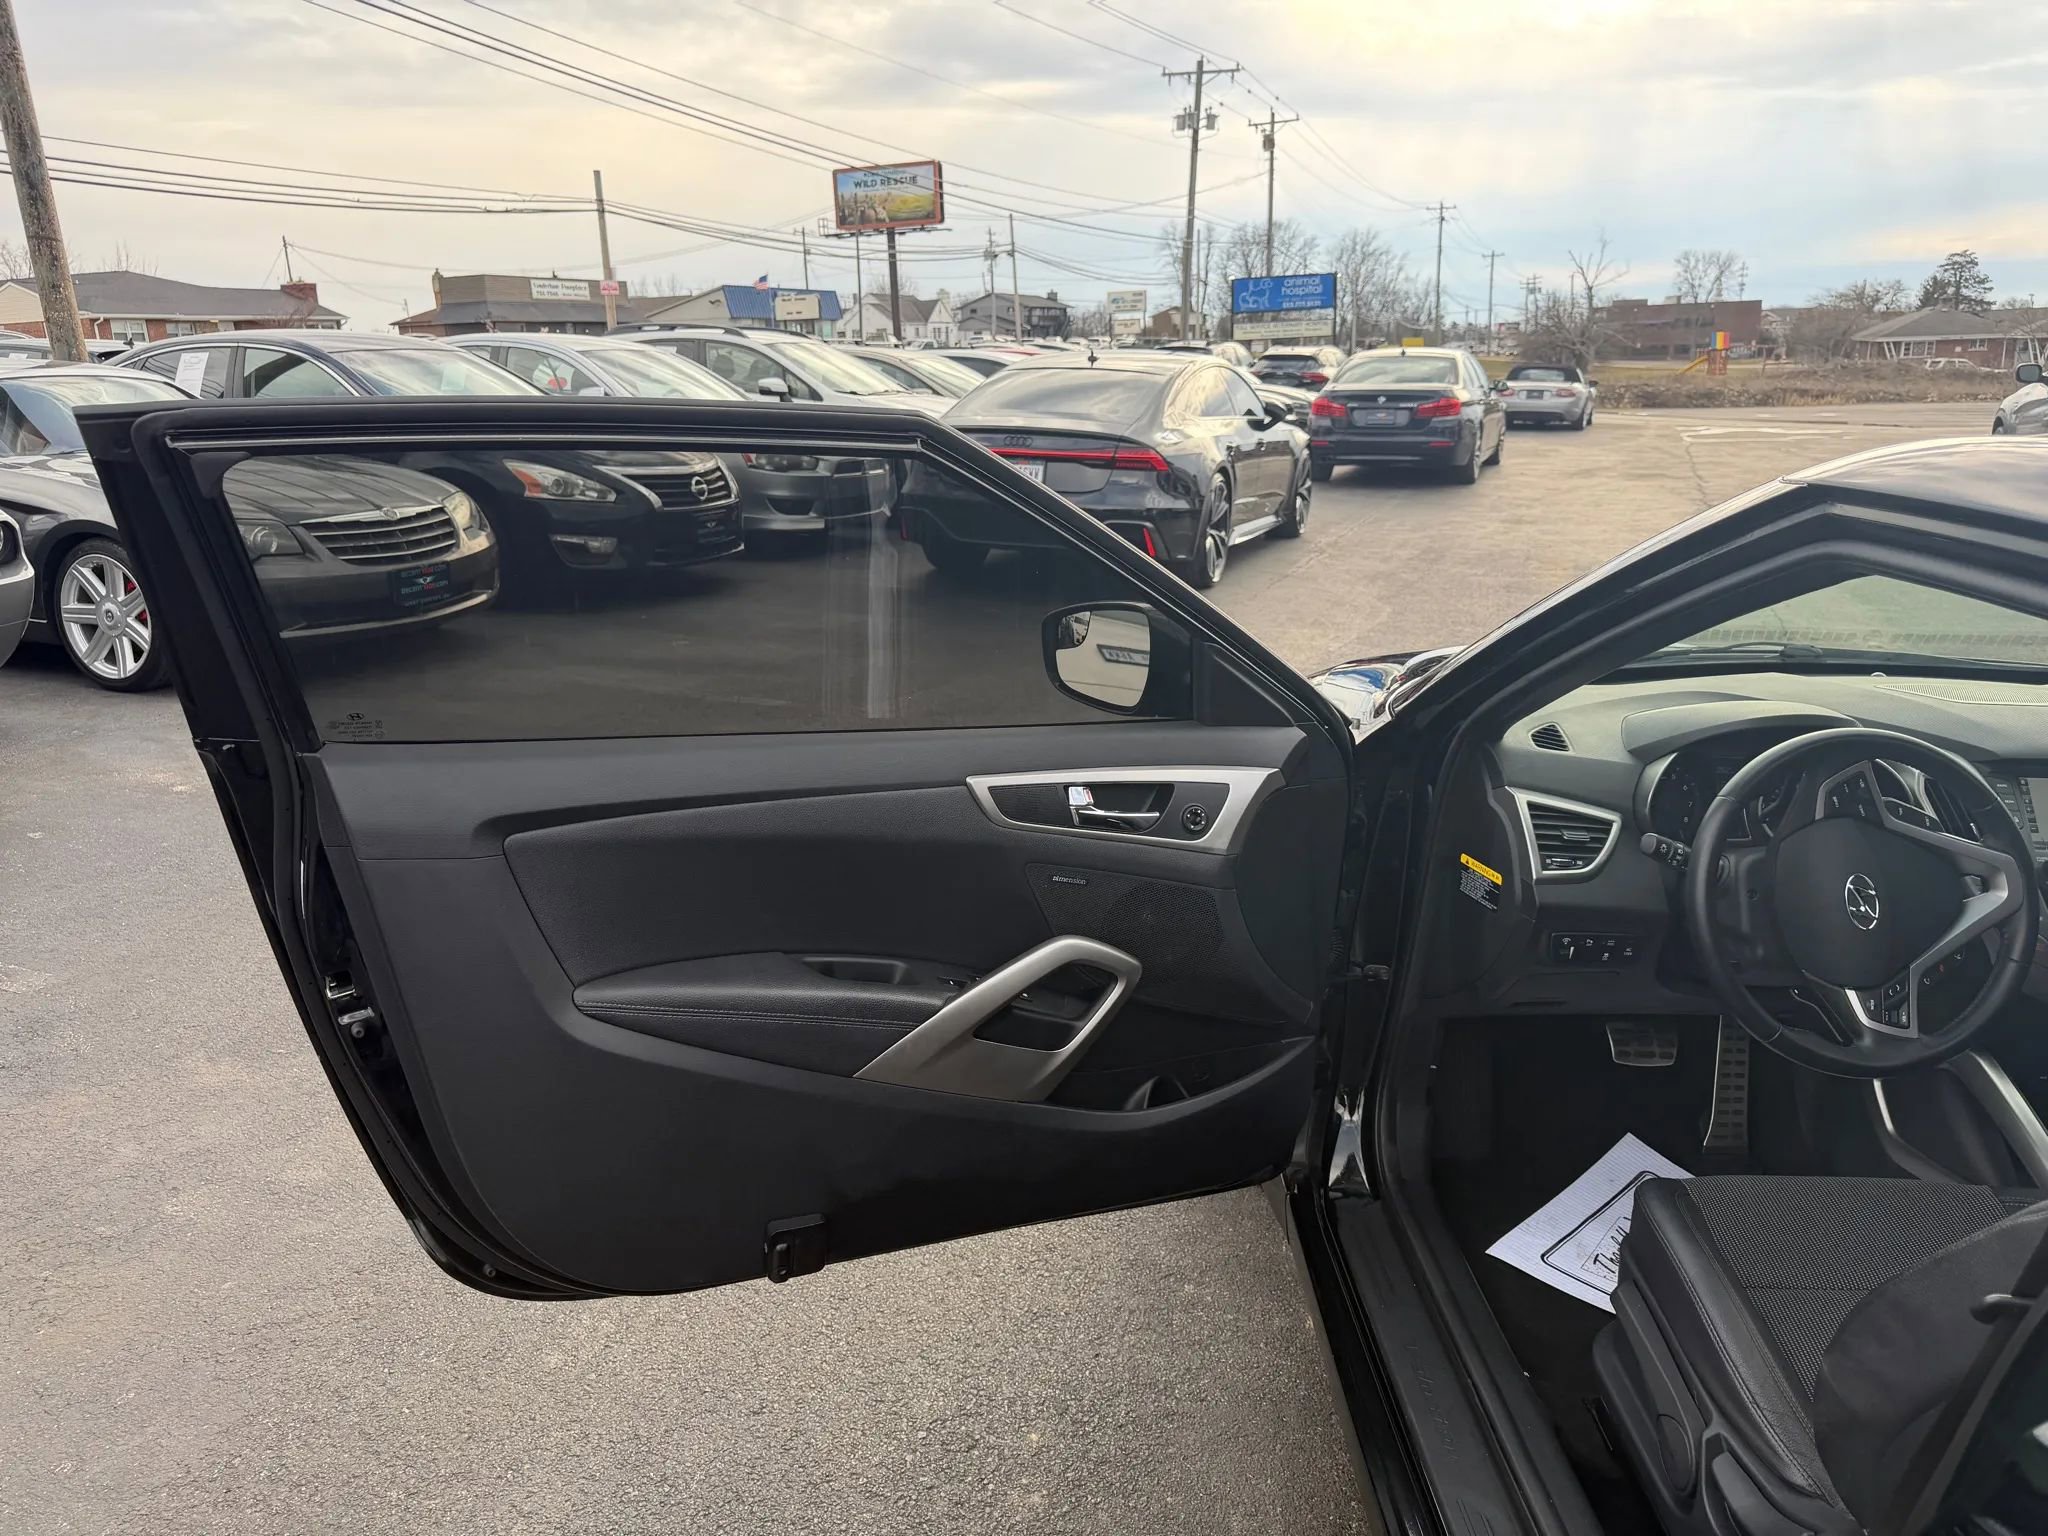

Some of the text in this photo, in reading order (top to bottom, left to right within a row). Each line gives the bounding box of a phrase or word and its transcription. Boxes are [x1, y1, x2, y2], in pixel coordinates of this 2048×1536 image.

[853, 179, 877, 189] WILD
[880, 175, 918, 187] RESCUE
[1284, 275, 1320, 286] animal
[1281, 284, 1323, 296] hospital
